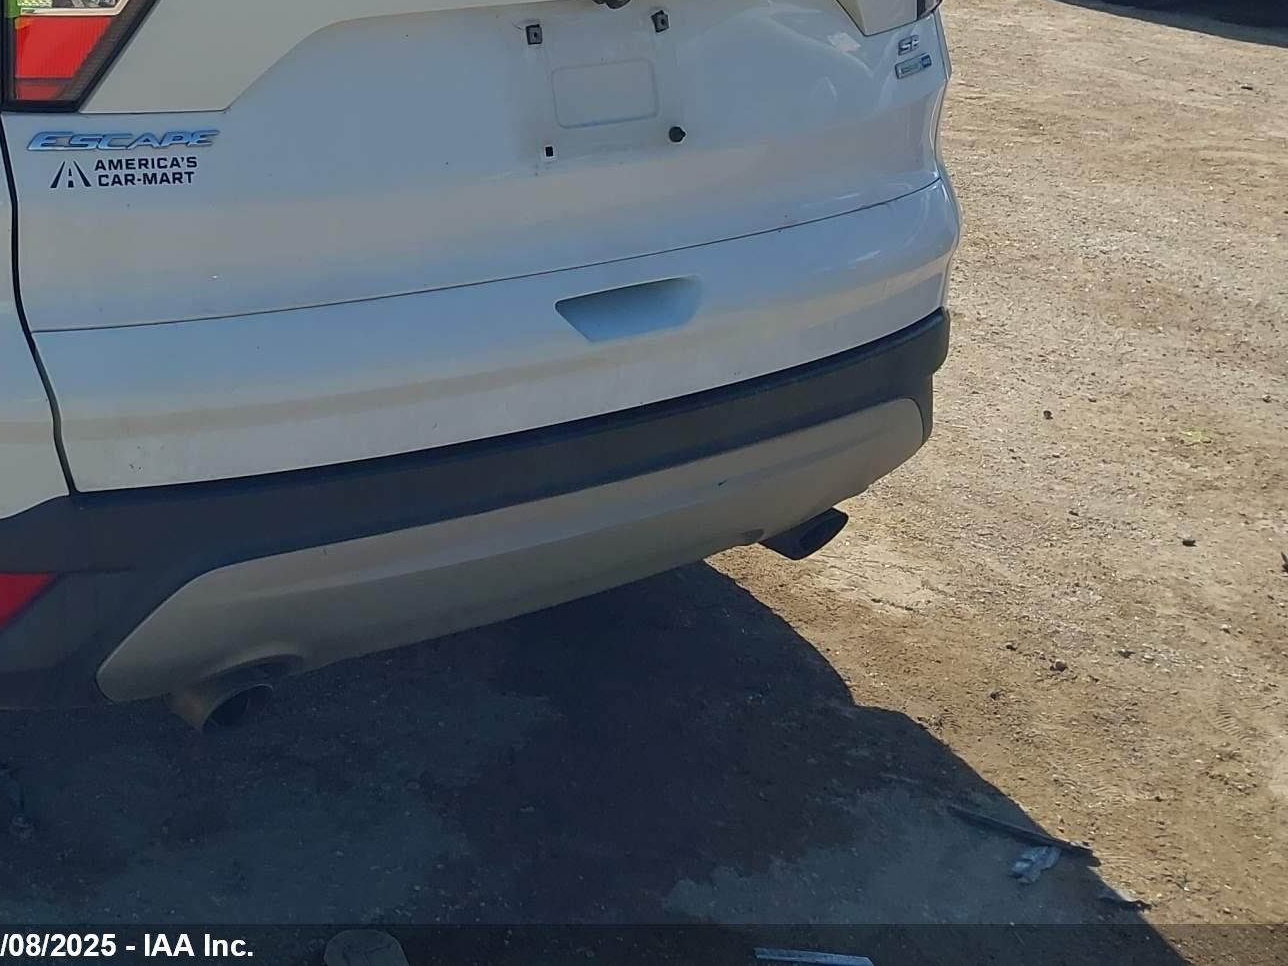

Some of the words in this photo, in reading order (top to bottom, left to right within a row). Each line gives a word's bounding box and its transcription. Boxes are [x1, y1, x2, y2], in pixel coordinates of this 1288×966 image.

[27, 130, 221, 151] ESCAPE
[94, 156, 198, 171] AMERICA'S
[98, 171, 195, 187] CAR-MART
